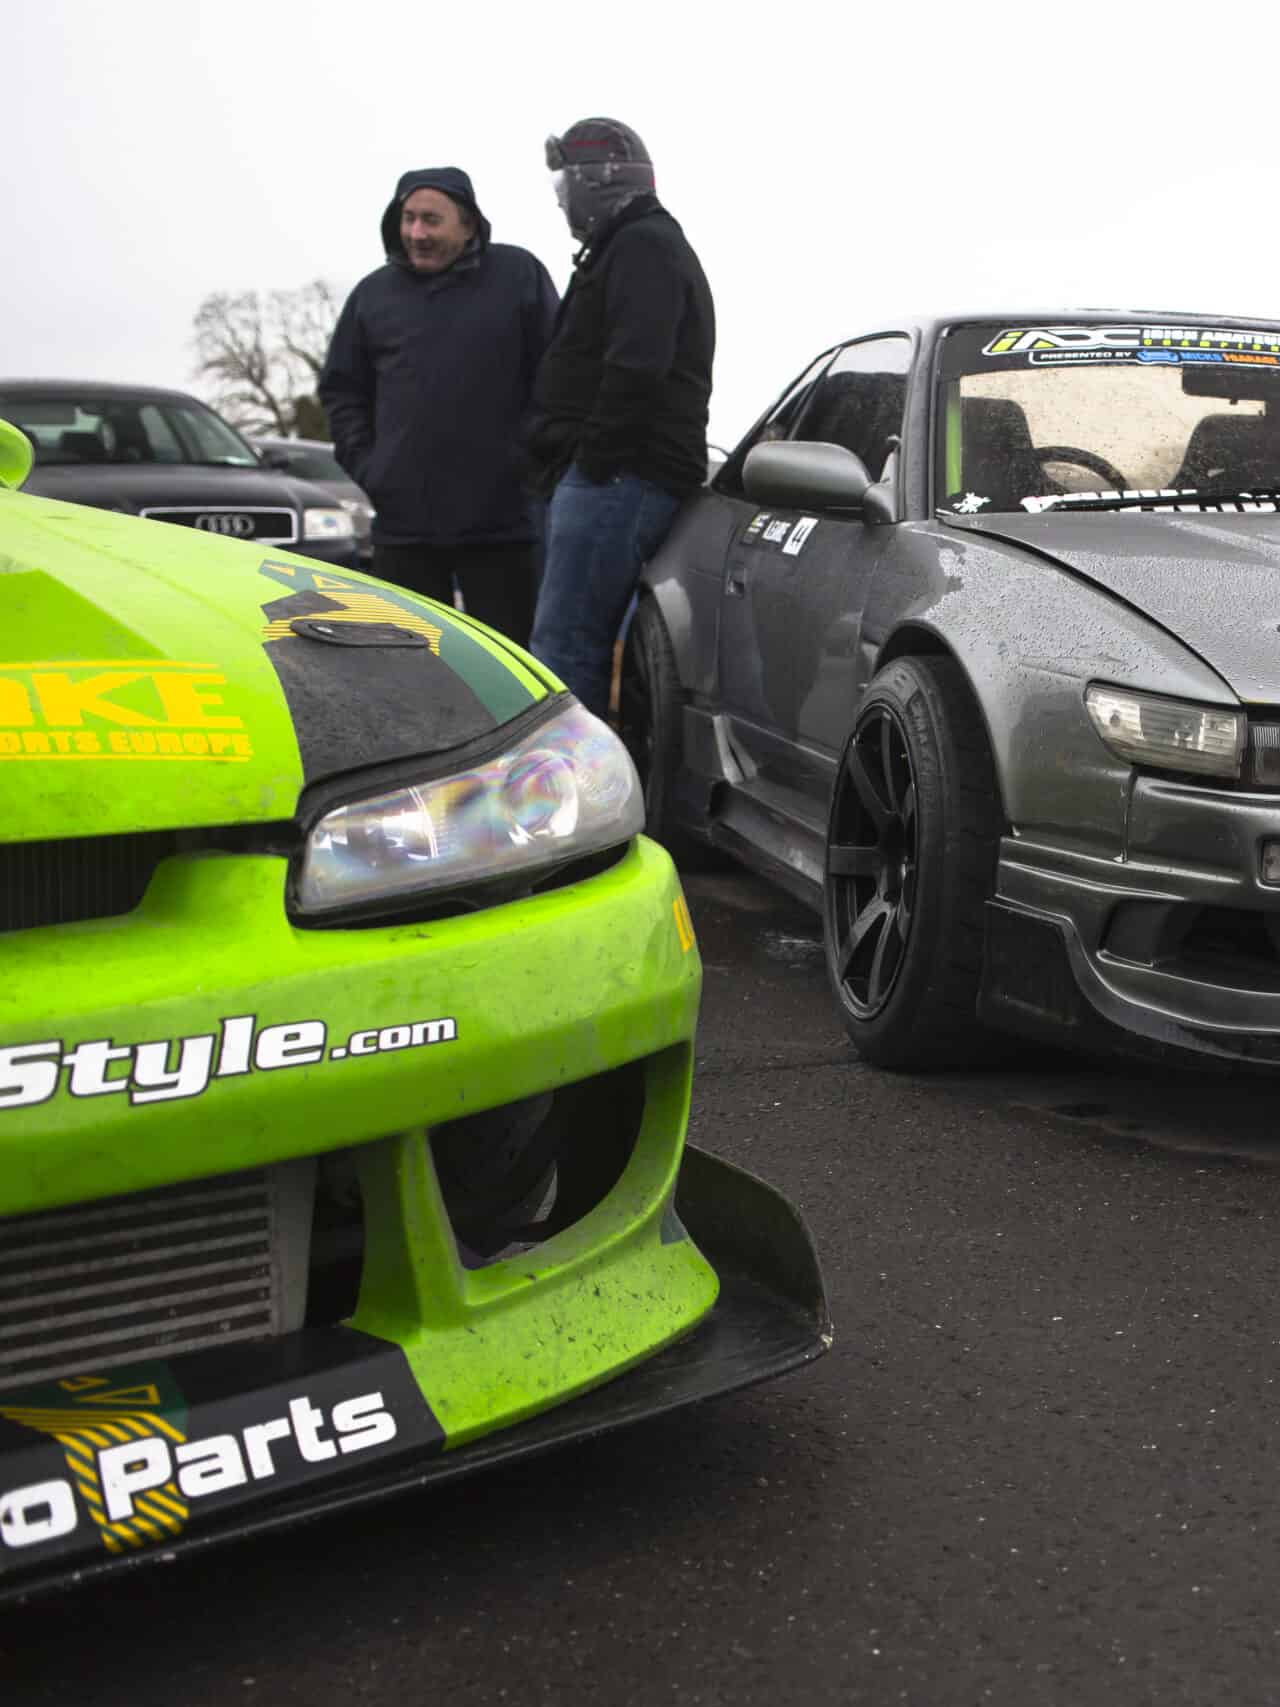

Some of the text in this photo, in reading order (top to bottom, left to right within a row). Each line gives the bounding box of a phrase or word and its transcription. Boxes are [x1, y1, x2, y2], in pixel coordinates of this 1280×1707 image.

[1115, 351, 1132, 359] BY
[107, 731, 253, 755] EUROPE
[98, 1391, 398, 1522] Parts
